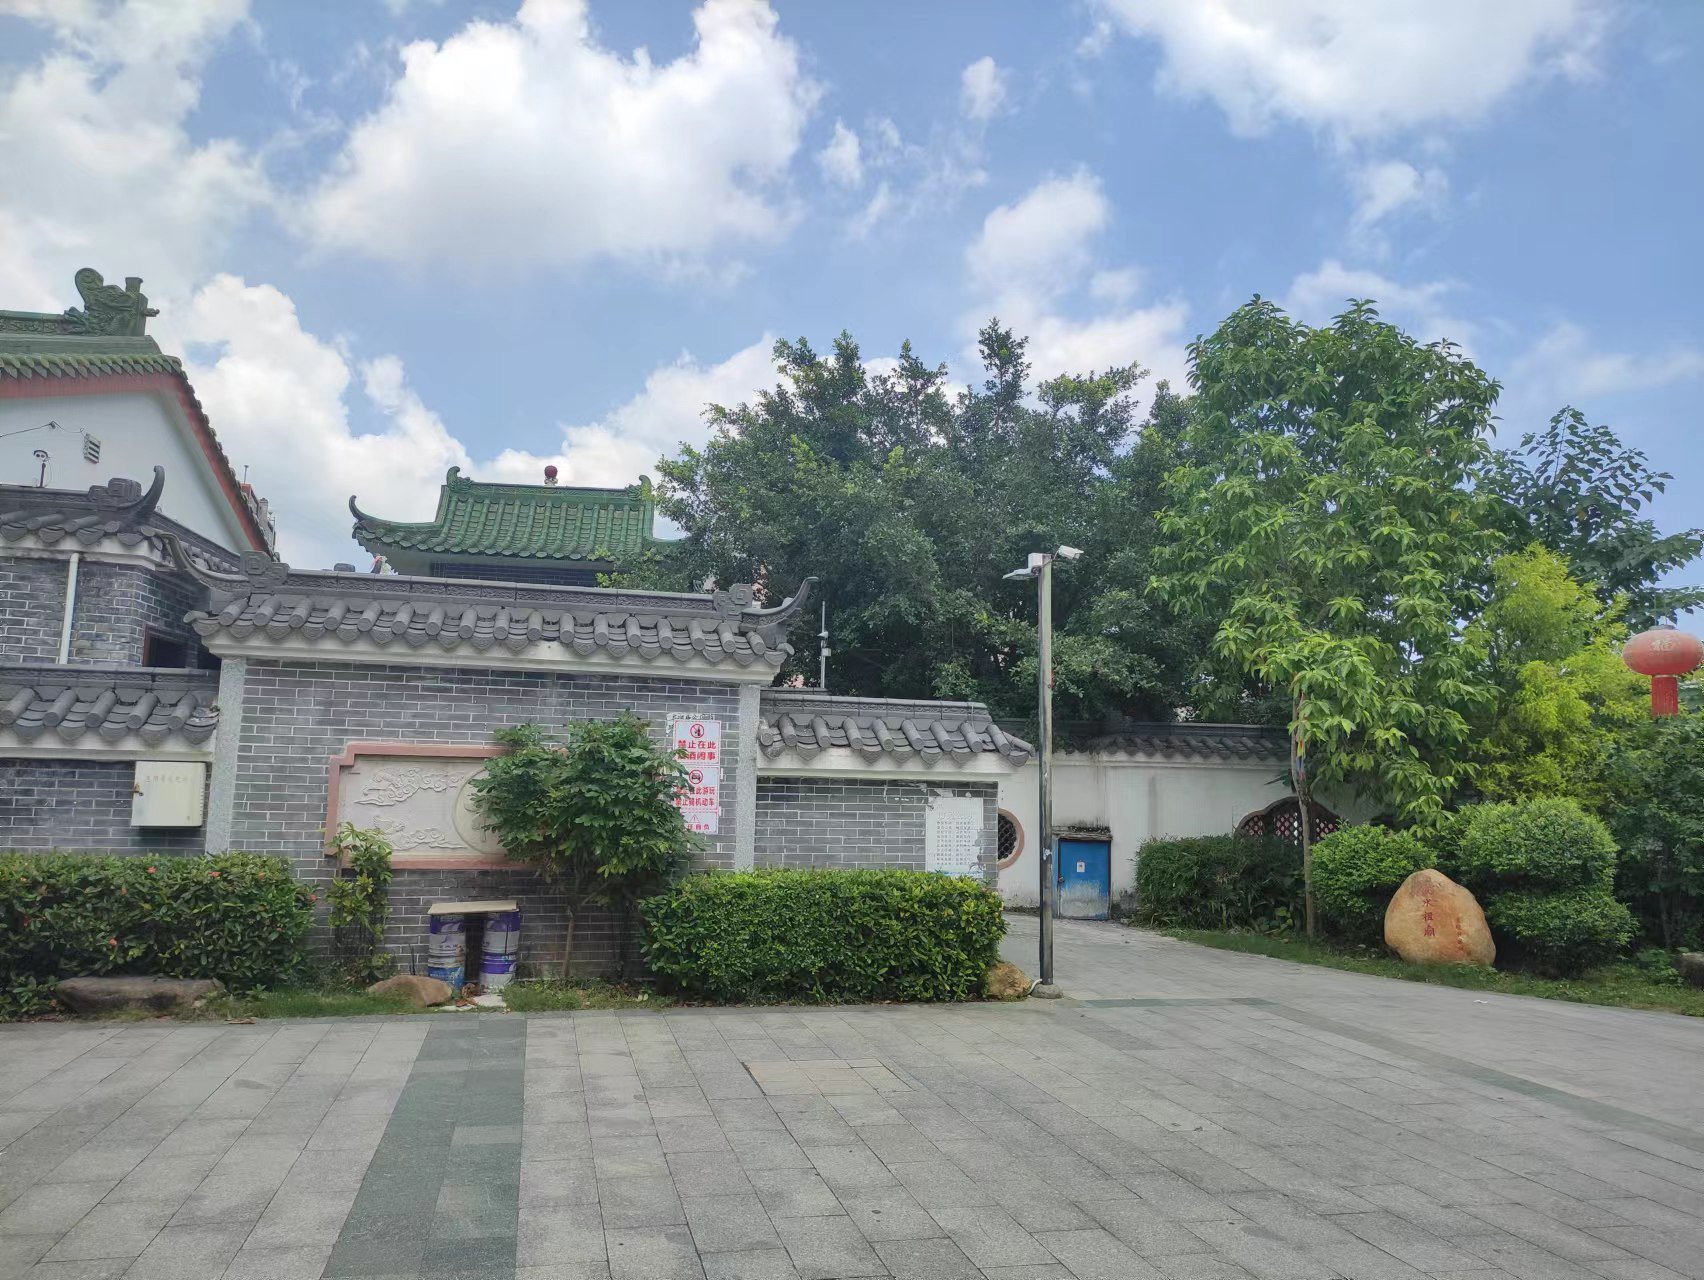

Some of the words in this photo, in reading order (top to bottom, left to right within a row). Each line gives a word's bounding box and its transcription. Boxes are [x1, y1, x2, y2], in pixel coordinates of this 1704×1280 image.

[677, 739, 716, 750] 禁止在此
[677, 751, 716, 761] 酒闹事
[675, 786, 716, 795] 禁止此游玩
